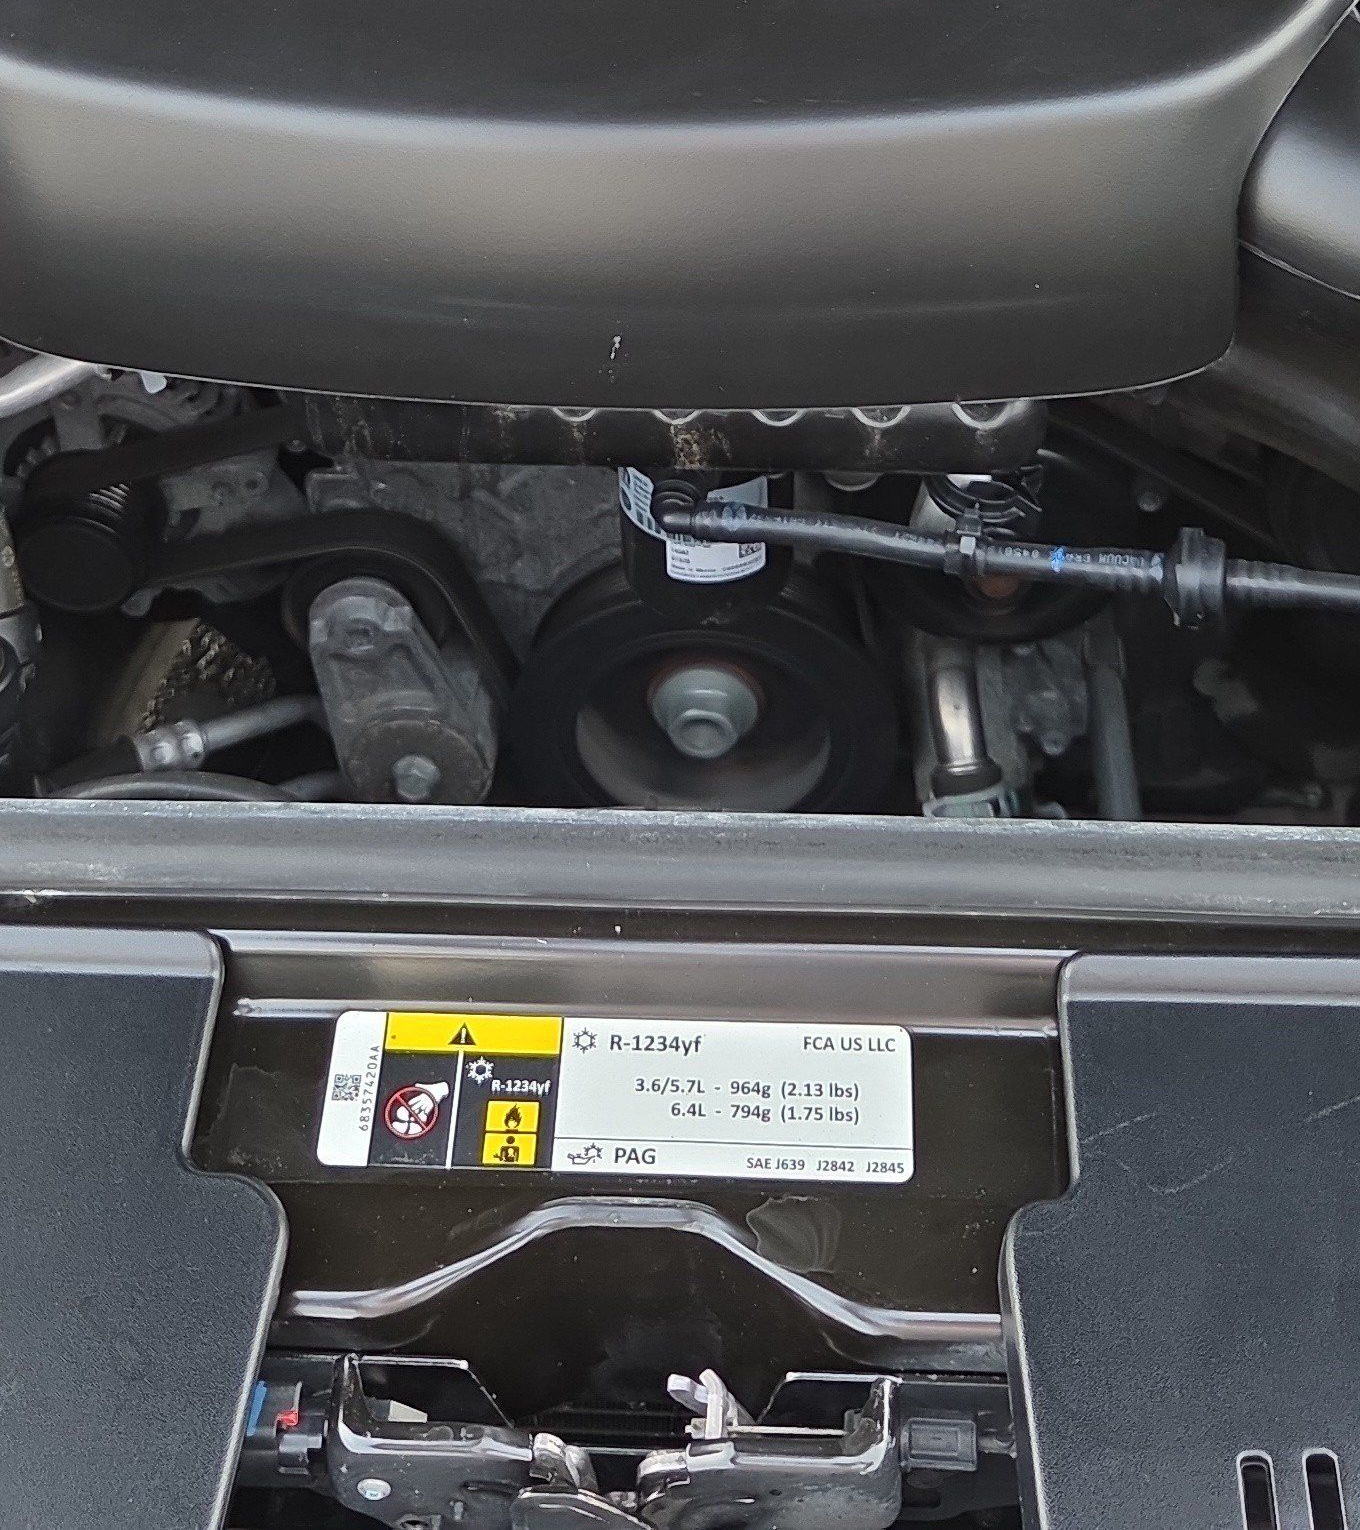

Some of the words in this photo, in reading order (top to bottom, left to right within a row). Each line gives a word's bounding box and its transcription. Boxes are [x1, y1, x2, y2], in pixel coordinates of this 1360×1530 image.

[609, 1034, 702, 1056] R-1234yf
[803, 1036, 834, 1051] FCA
[840, 1037, 862, 1052] US
[868, 1038, 896, 1052] LLC
[359, 1045, 380, 1131] 68357420AA
[491, 1079, 551, 1097] R-1234yf
[635, 1078, 705, 1095] 3.6/5.7L
[730, 1081, 771, 1099] 964g
[781, 1082, 824, 1101] (2.13
[829, 1082, 859, 1101] lbs)
[671, 1103, 706, 1118] 6.4L
[730, 1104, 771, 1122] 794g
[781, 1106, 824, 1124] (1.75
[829, 1105, 859, 1125] lbs)
[614, 1148, 657, 1165] PAG
[747, 1157, 771, 1170] SAE
[775, 1158, 805, 1171] J639
[816, 1160, 855, 1173] J2842
[866, 1161, 905, 1174] J2845
